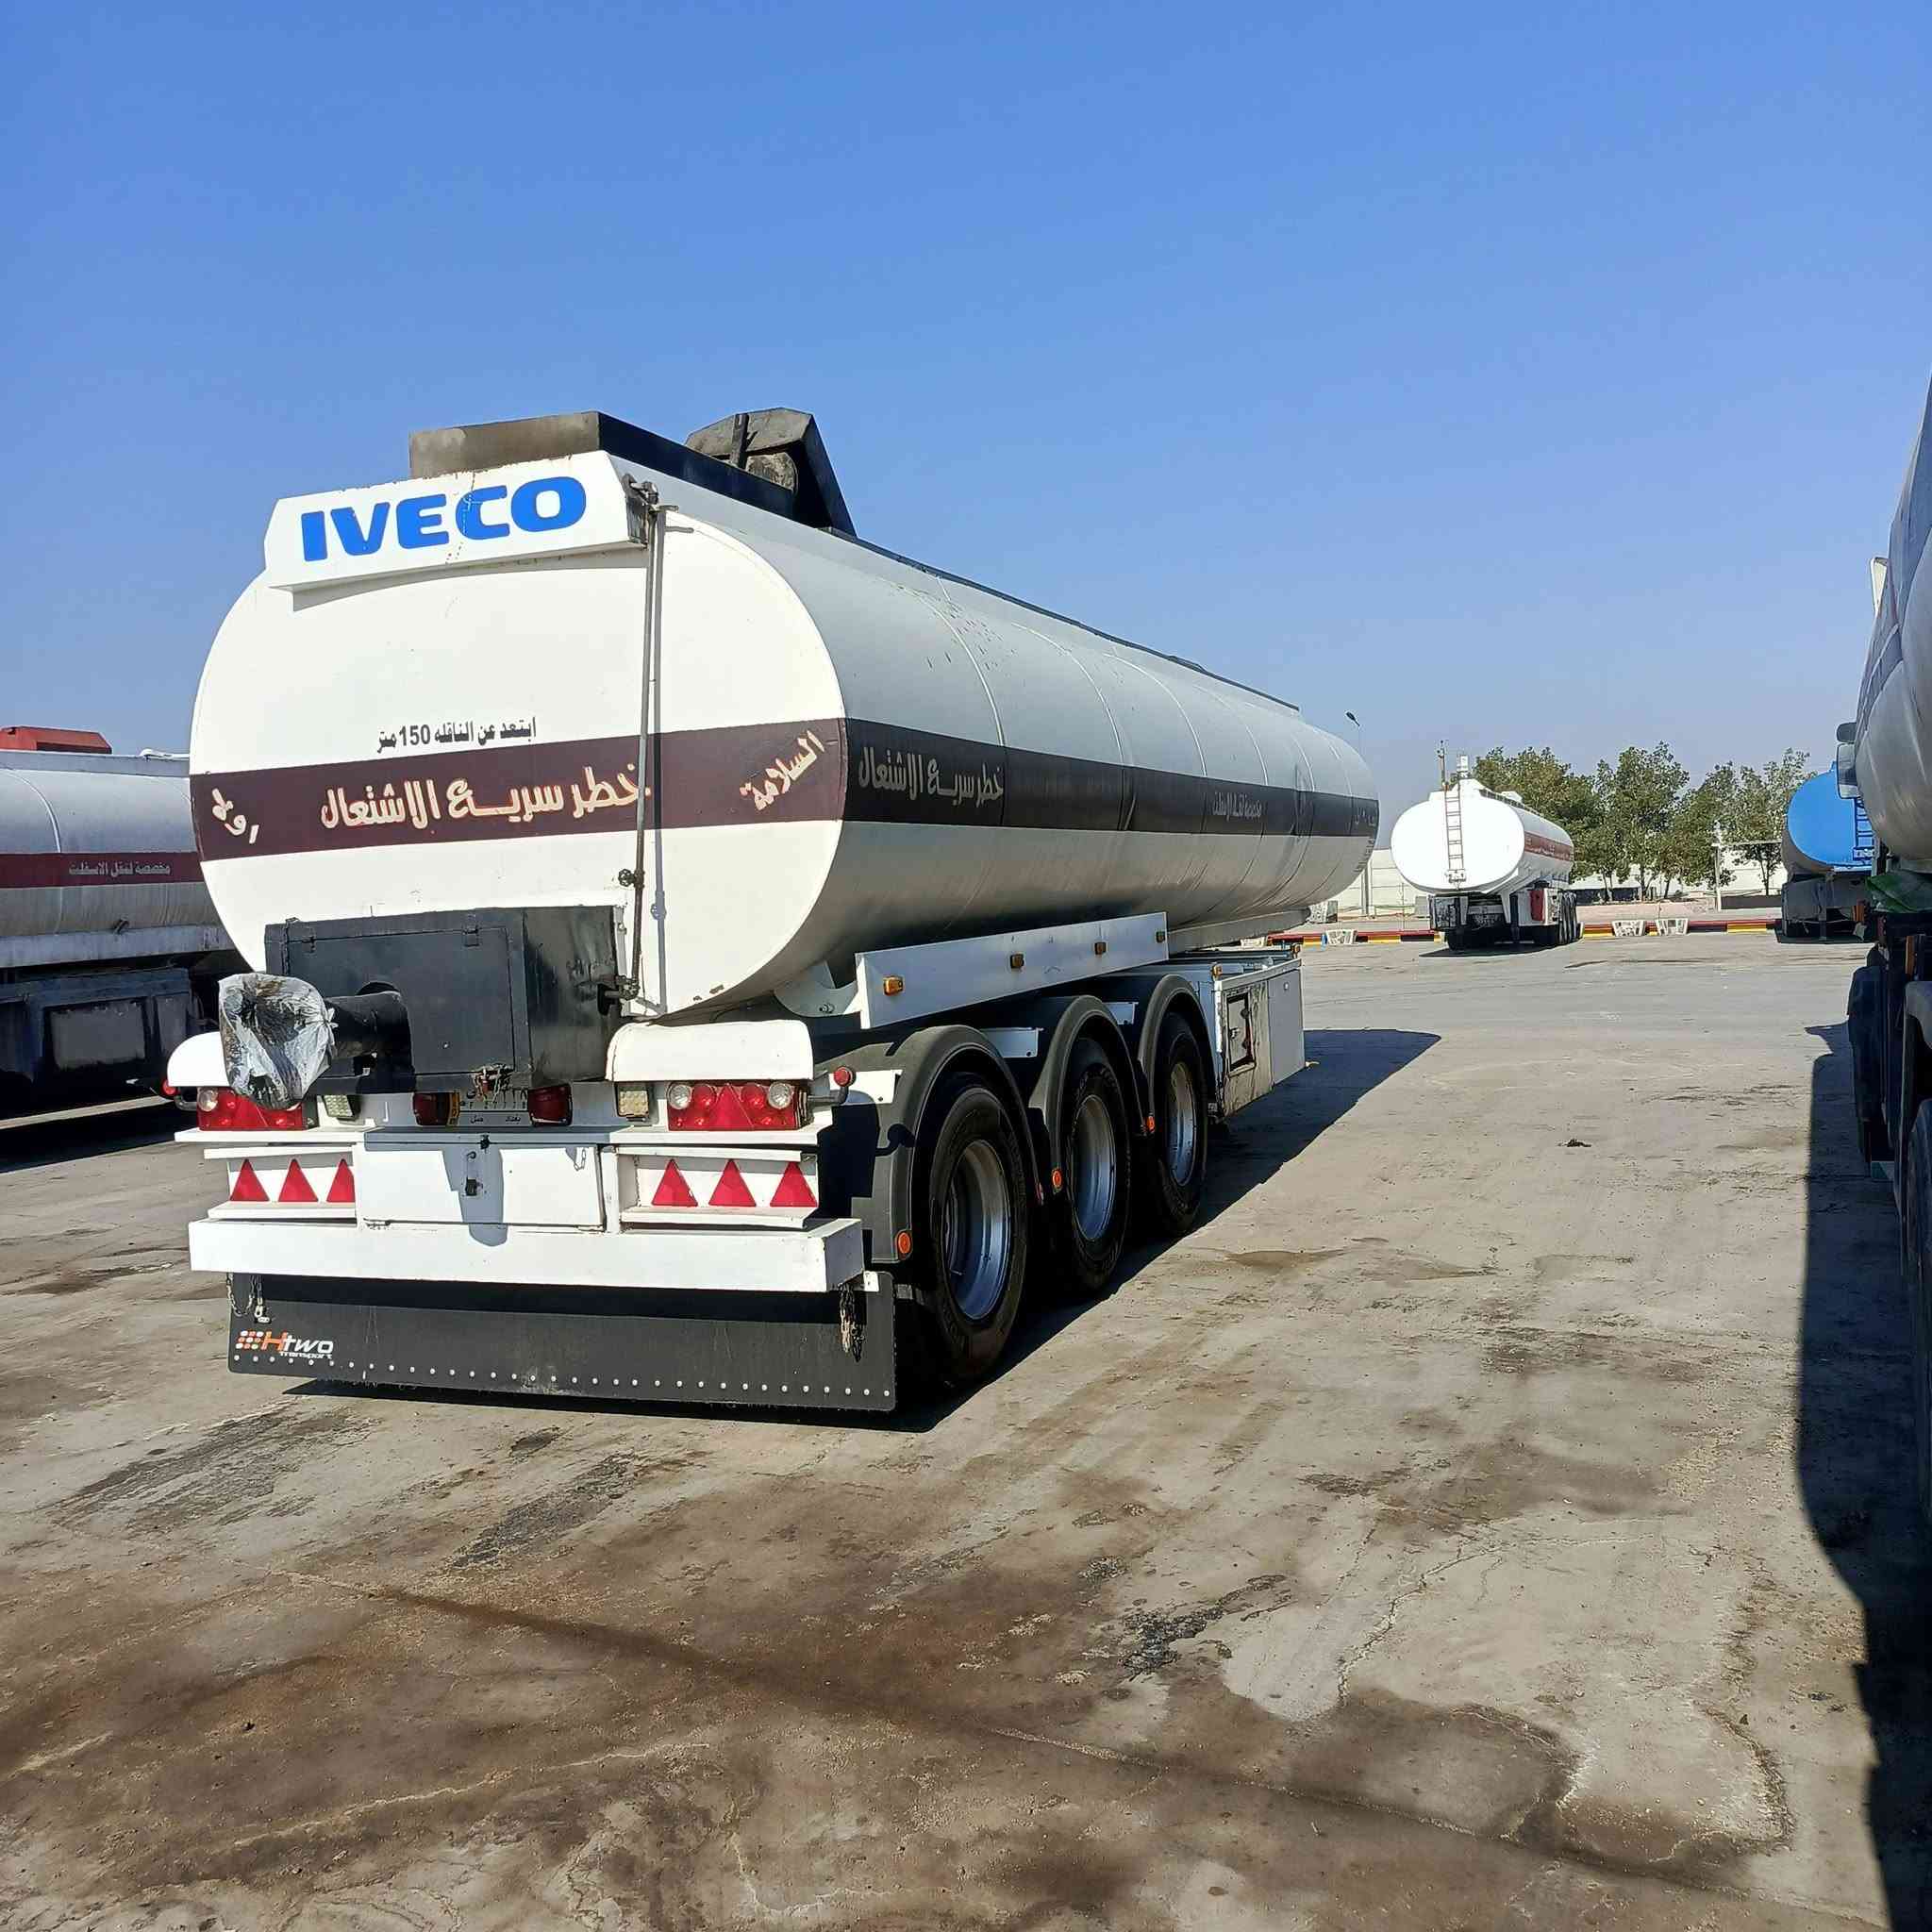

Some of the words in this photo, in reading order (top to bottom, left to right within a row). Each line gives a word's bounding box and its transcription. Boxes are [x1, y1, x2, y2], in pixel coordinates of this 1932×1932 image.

[301, 475, 587, 562] IVECO
[377, 731, 397, 754] متر
[398, 724, 431, 746] 150
[477, 724, 496, 746] عن
[499, 717, 537, 742] ابتعد
[572, 762, 652, 819] خطر
[858, 746, 924, 801] الاشتعال
[321, 778, 441, 829] الاشتعال
